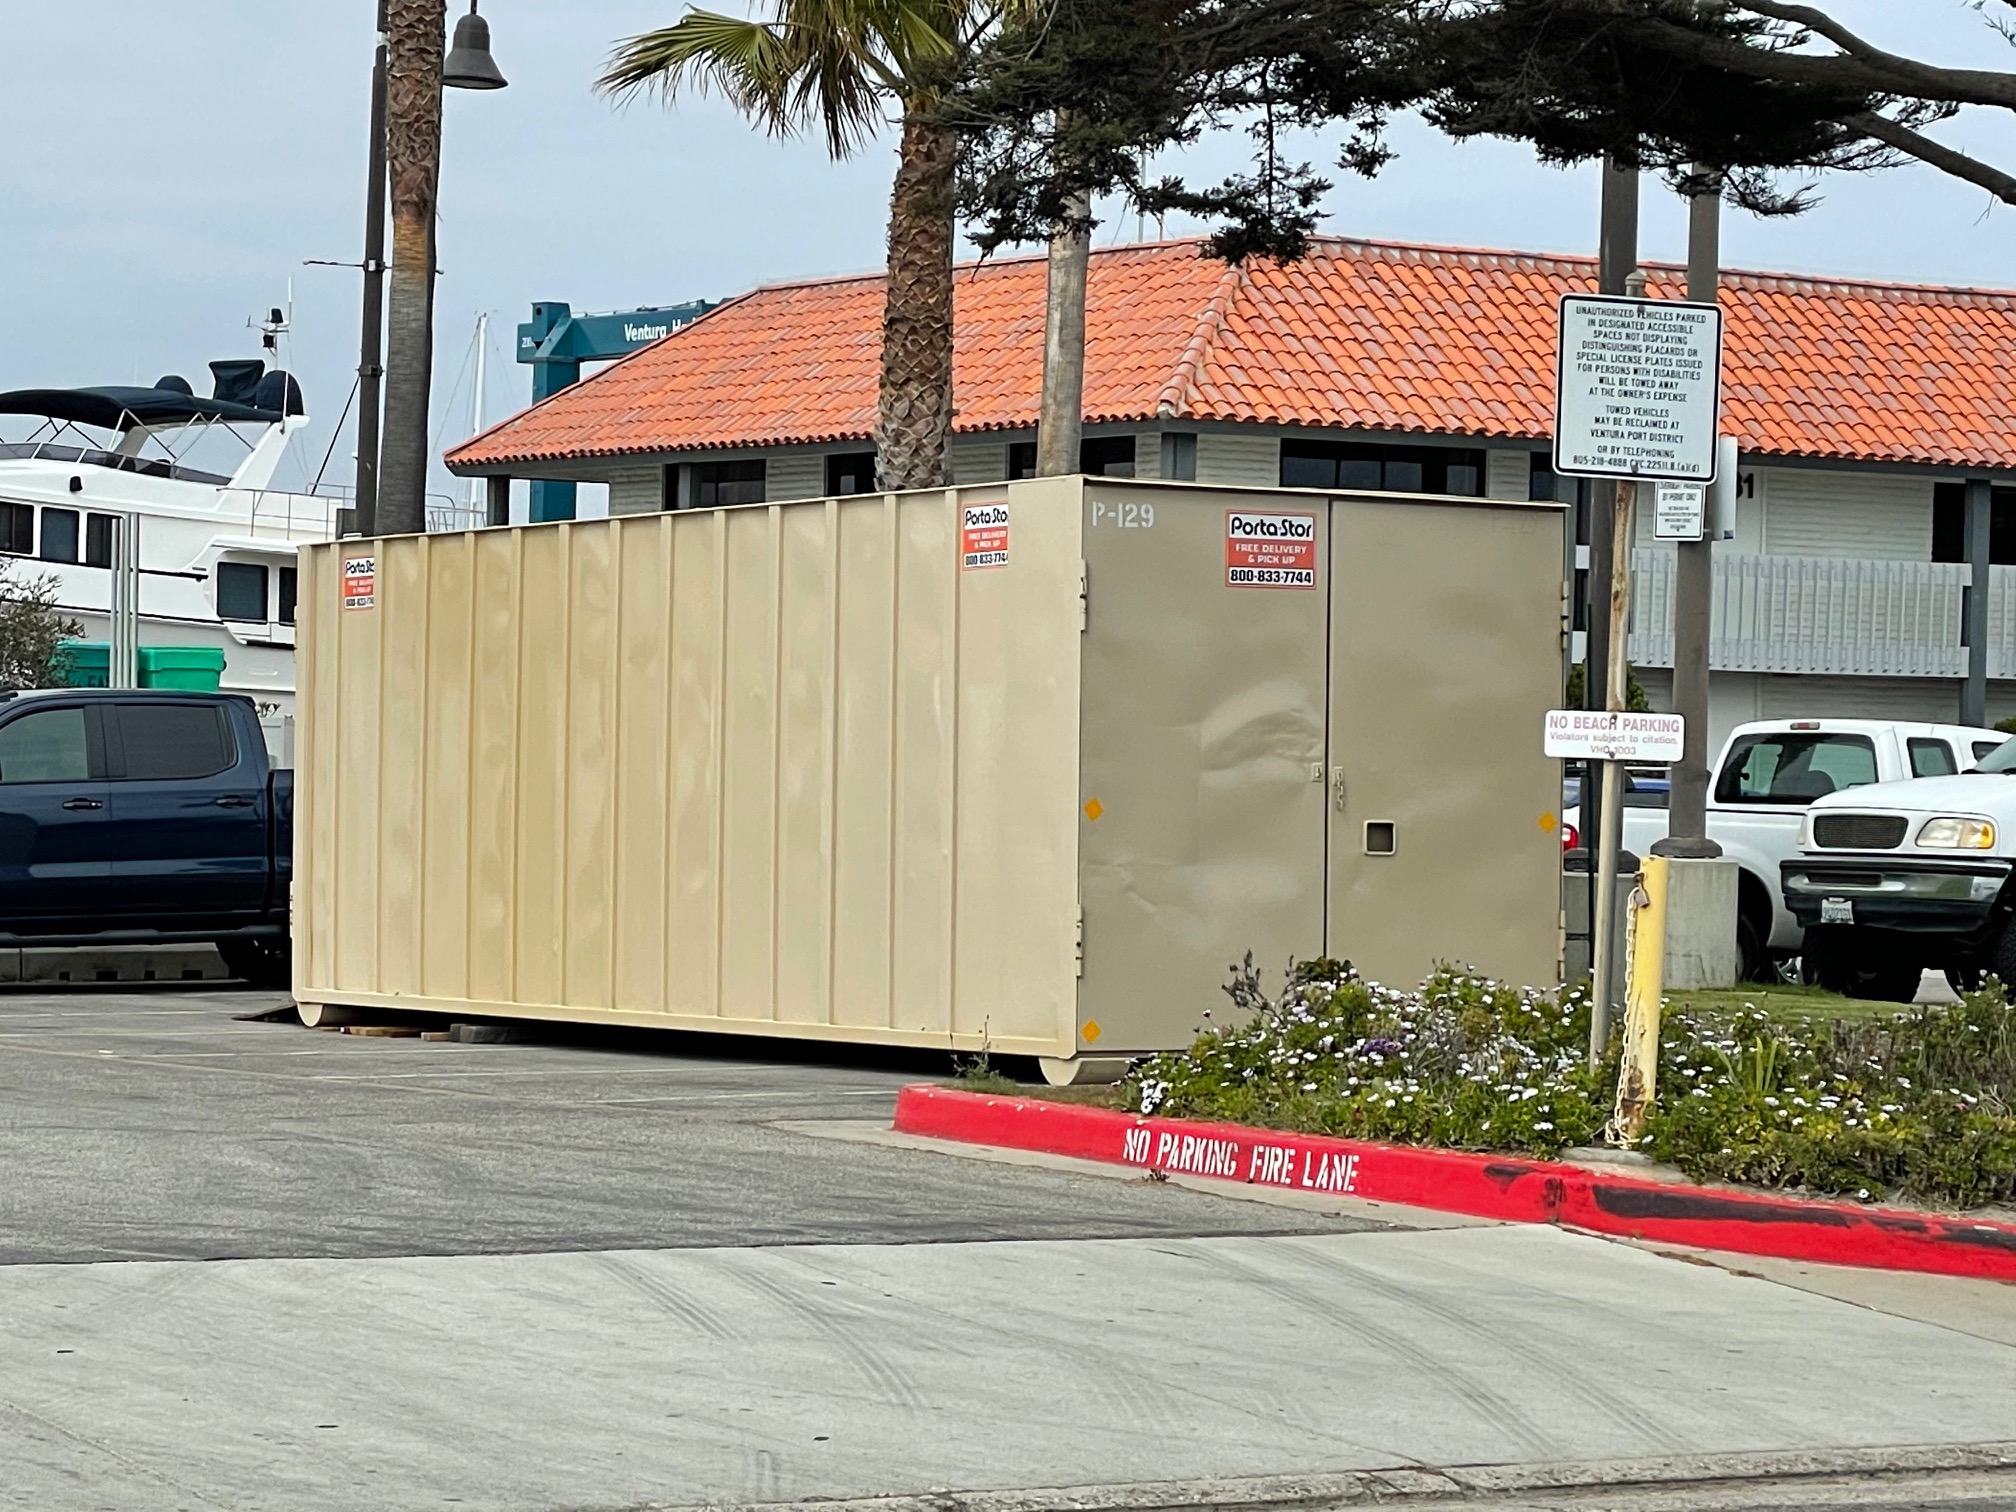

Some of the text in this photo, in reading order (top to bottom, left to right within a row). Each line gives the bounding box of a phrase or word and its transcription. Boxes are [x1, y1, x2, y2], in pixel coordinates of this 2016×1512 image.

[1576, 306, 1634, 318] UNAUTHORIZED
[1676, 313, 1706, 324] PARKED
[624, 323, 667, 341] Ventura
[1588, 318, 1694, 334] IN DESIGNATED ACCESSIBLE
[1594, 330, 1688, 345] SPACES NOT DISPLAYING
[1582, 340, 1698, 357] DISTINGUISHING PLACARDS OR
[1576, 352, 1703, 369] SPECIAL LICENSE PLATES ISSUED
[1578, 363, 1701, 380] FOR PERSONS WITH DISABILITIES
[1599, 376, 1679, 390] WILL BE TOWED AWAY
[1589, 387, 1687, 402] AT THE OWNER'S EXPENSE
[1606, 405, 1670, 418] TOWED VEHICLES
[1594, 416, 1680, 430] MAY BE RECLAIMED AT
[1590, 429, 1684, 444] VENTURA PORT DISTRICT
[1597, 445, 1675, 459] OR BY TELEPHONING
[1092, 501, 1154, 528] P-129
[1236, 543, 1307, 554] FREE DELIVERY
[1248, 554, 1296, 564] & PICK UP
[1230, 569, 1311, 583] 800-833-7744
[1549, 715, 1680, 733] NO BEACH PARKING
[1549, 732, 1589, 742] Violators
[1593, 734, 1626, 744] subject
[1629, 735, 1639, 743] to
[1614, 746, 1637, 755] 1003
[1123, 1128, 1360, 1192] NO PARKING FIRE LANE
